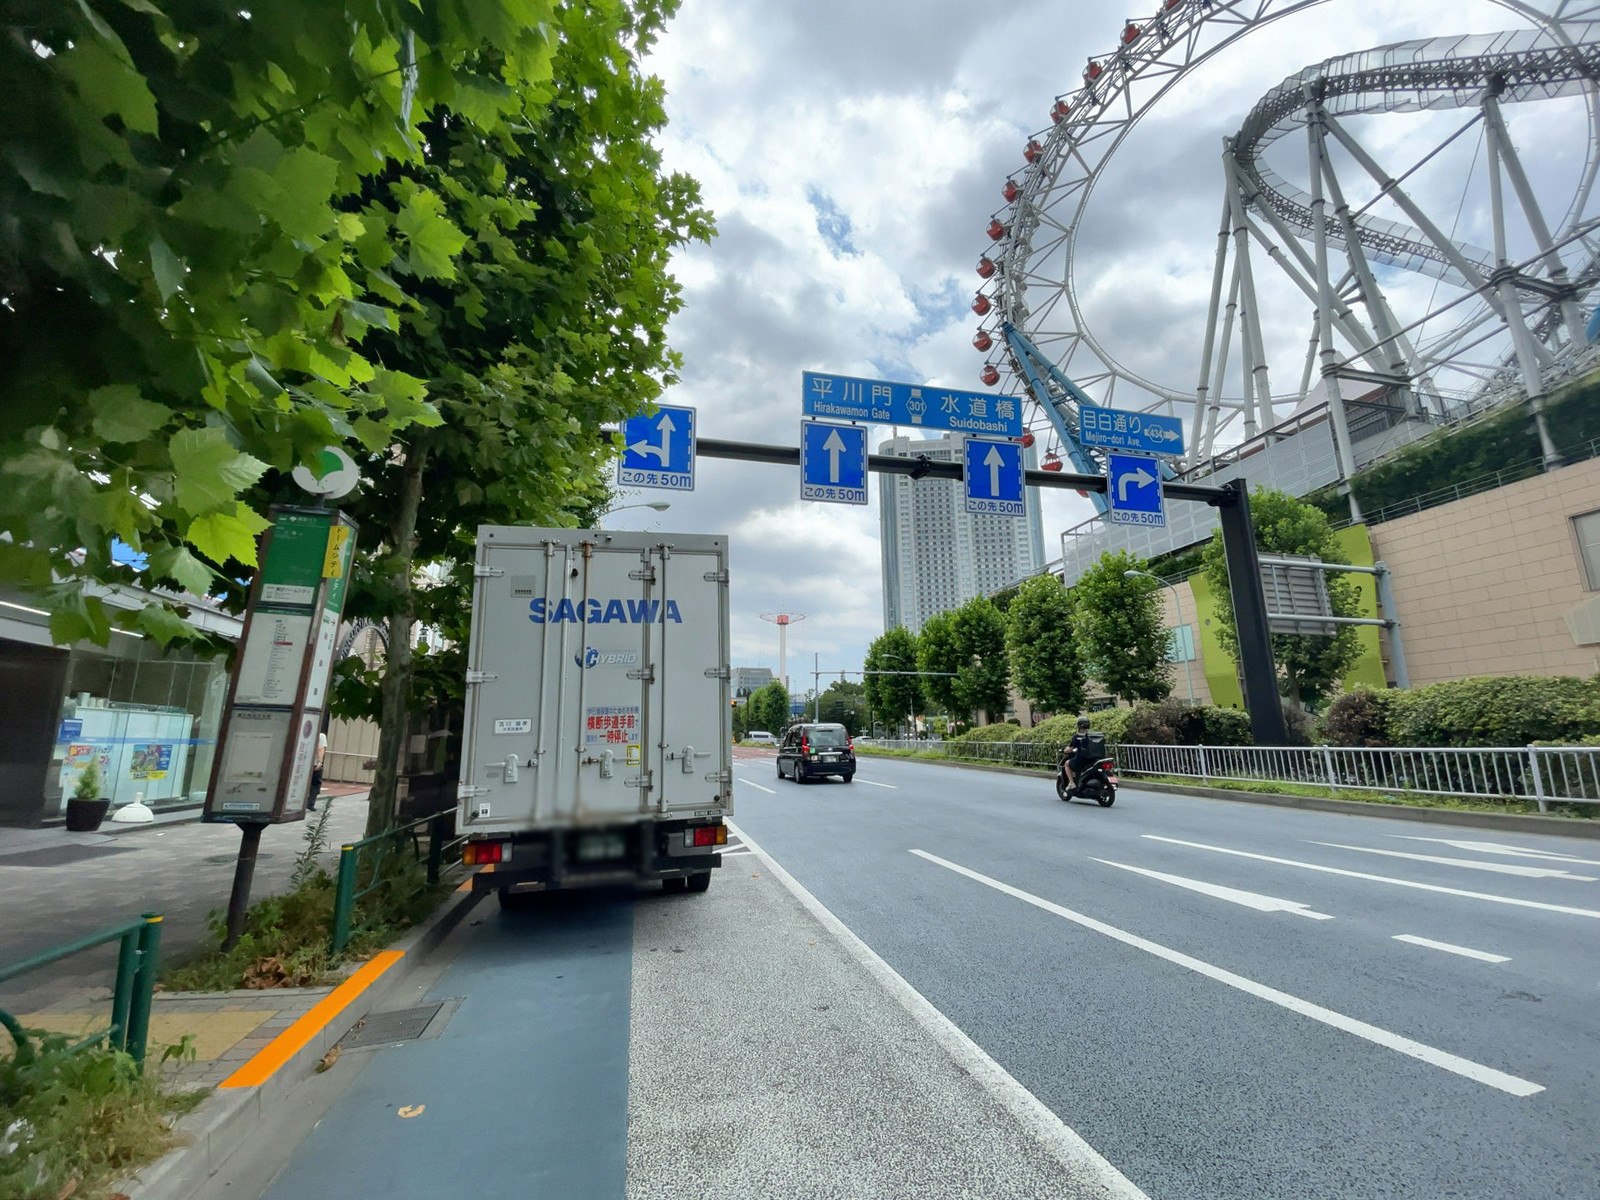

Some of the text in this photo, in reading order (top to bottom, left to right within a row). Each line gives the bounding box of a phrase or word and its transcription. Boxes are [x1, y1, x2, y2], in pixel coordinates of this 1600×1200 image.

[812, 377, 892, 406] 平川門
[814, 400, 891, 420] Hirakawamon Gate
[909, 400, 925, 411] 301
[940, 394, 1015, 420] 水道橋
[949, 416, 1008, 432] Suidobashi
[1083, 409, 1141, 434] 目白通り
[1086, 430, 1142, 447] Mejiro-dori Ave.
[1150, 428, 1163, 439] 434
[622, 471, 692, 488] この先50m
[804, 486, 866, 502] この先50m
[968, 500, 1024, 514] この先50m
[1113, 511, 1164, 525] この先50m
[330, 526, 344, 577] ドームシティ
[528, 597, 683, 624] SAGAWA
[589, 653, 637, 665] HYBRID
